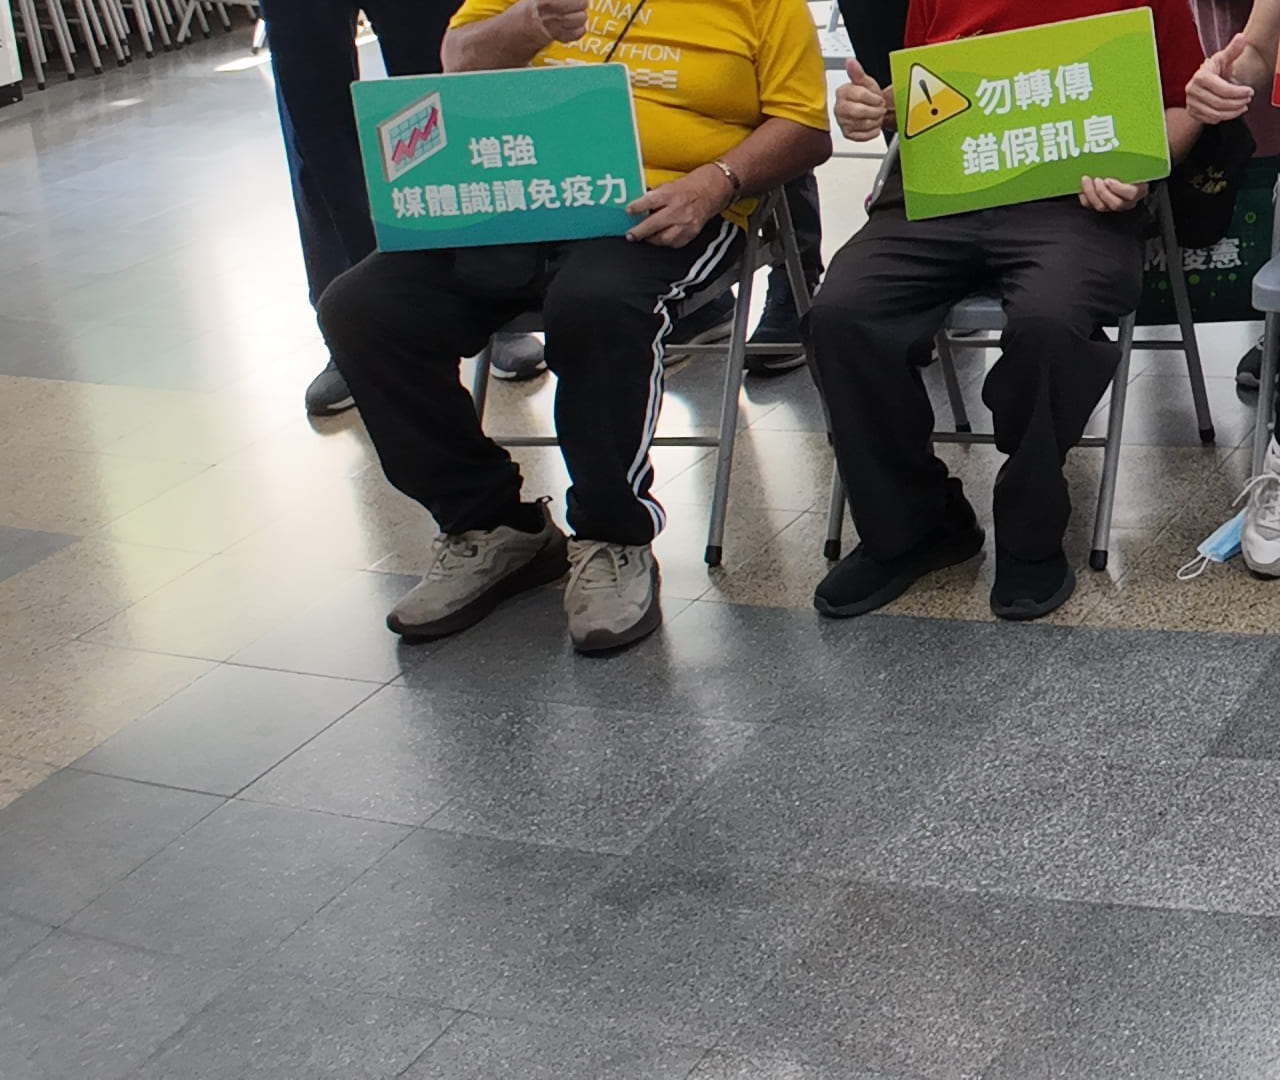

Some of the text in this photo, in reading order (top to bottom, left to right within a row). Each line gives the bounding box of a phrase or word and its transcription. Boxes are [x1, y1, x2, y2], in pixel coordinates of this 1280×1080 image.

[561, 36, 681, 63] ARATHON
[974, 60, 1094, 118] 勿轉傳
[467, 133, 539, 170] 增強
[960, 114, 1121, 178] 錯假訊息
[390, 172, 629, 219] 媒體識讀免疫力
